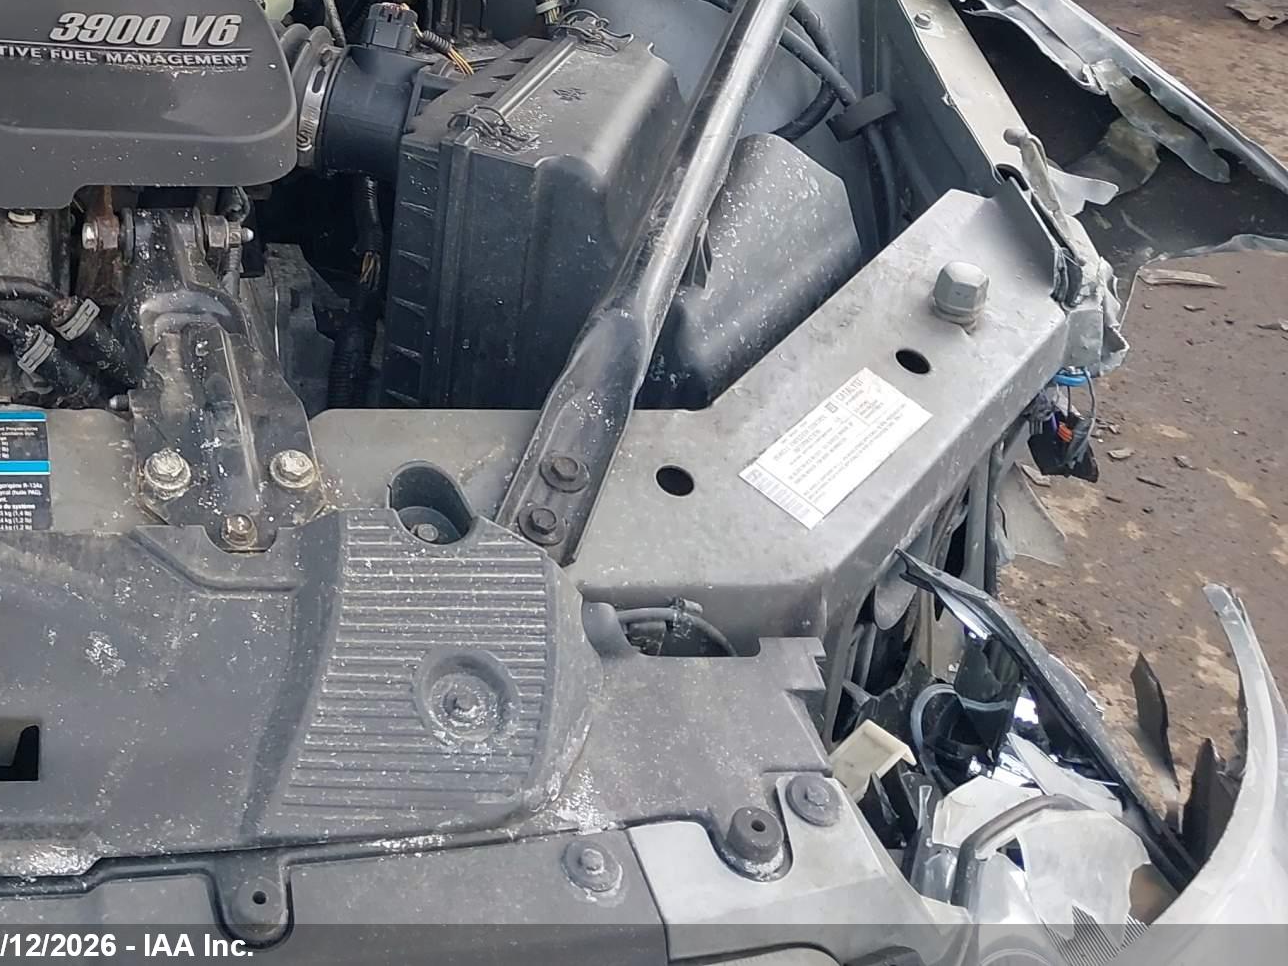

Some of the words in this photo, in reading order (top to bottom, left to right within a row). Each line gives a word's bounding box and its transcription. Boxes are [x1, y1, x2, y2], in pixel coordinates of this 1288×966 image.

[49, 12, 172, 45] 3900
[180, 14, 243, 47] V6
[50, 49, 97, 62] FUEL
[104, 52, 250, 67] MANAGEMENT
